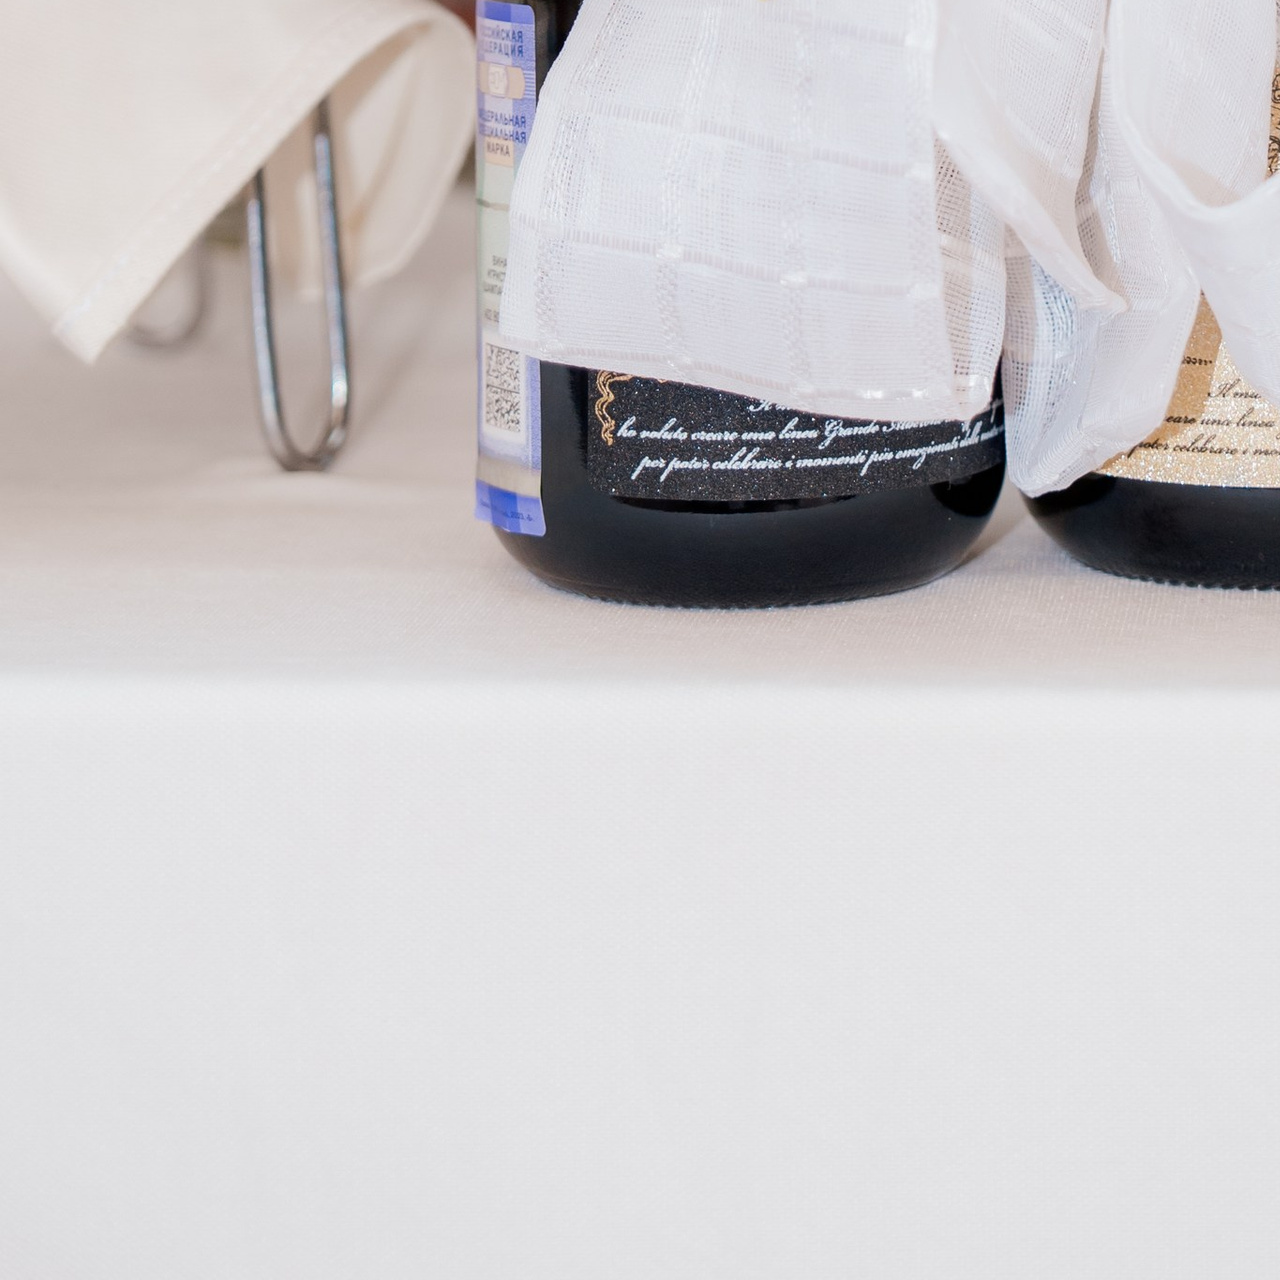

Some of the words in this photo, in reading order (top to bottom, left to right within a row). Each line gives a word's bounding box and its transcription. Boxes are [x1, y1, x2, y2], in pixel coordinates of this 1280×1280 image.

[480, 25, 524, 44] ССИЙСКАЯ
[480, 40, 524, 58] ЕРАЦИЯ
[487, 141, 511, 158] МАРКА
[1165, 414, 1197, 426] eare
[1200, 417, 1230, 427] una
[1236, 407, 1276, 428] linea
[617, 416, 637, 438] ho
[640, 417, 688, 440] voluto
[691, 430, 739, 441] creare
[741, 430, 776, 441] una
[778, 416, 819, 439] linea
[818, 419, 880, 450] Grande
[1173, 434, 1239, 456] celebrare
[630, 455, 667, 481] per
[660, 456, 710, 482] poter
[711, 446, 782, 470] celebrare
[795, 449, 869, 469] momenti
